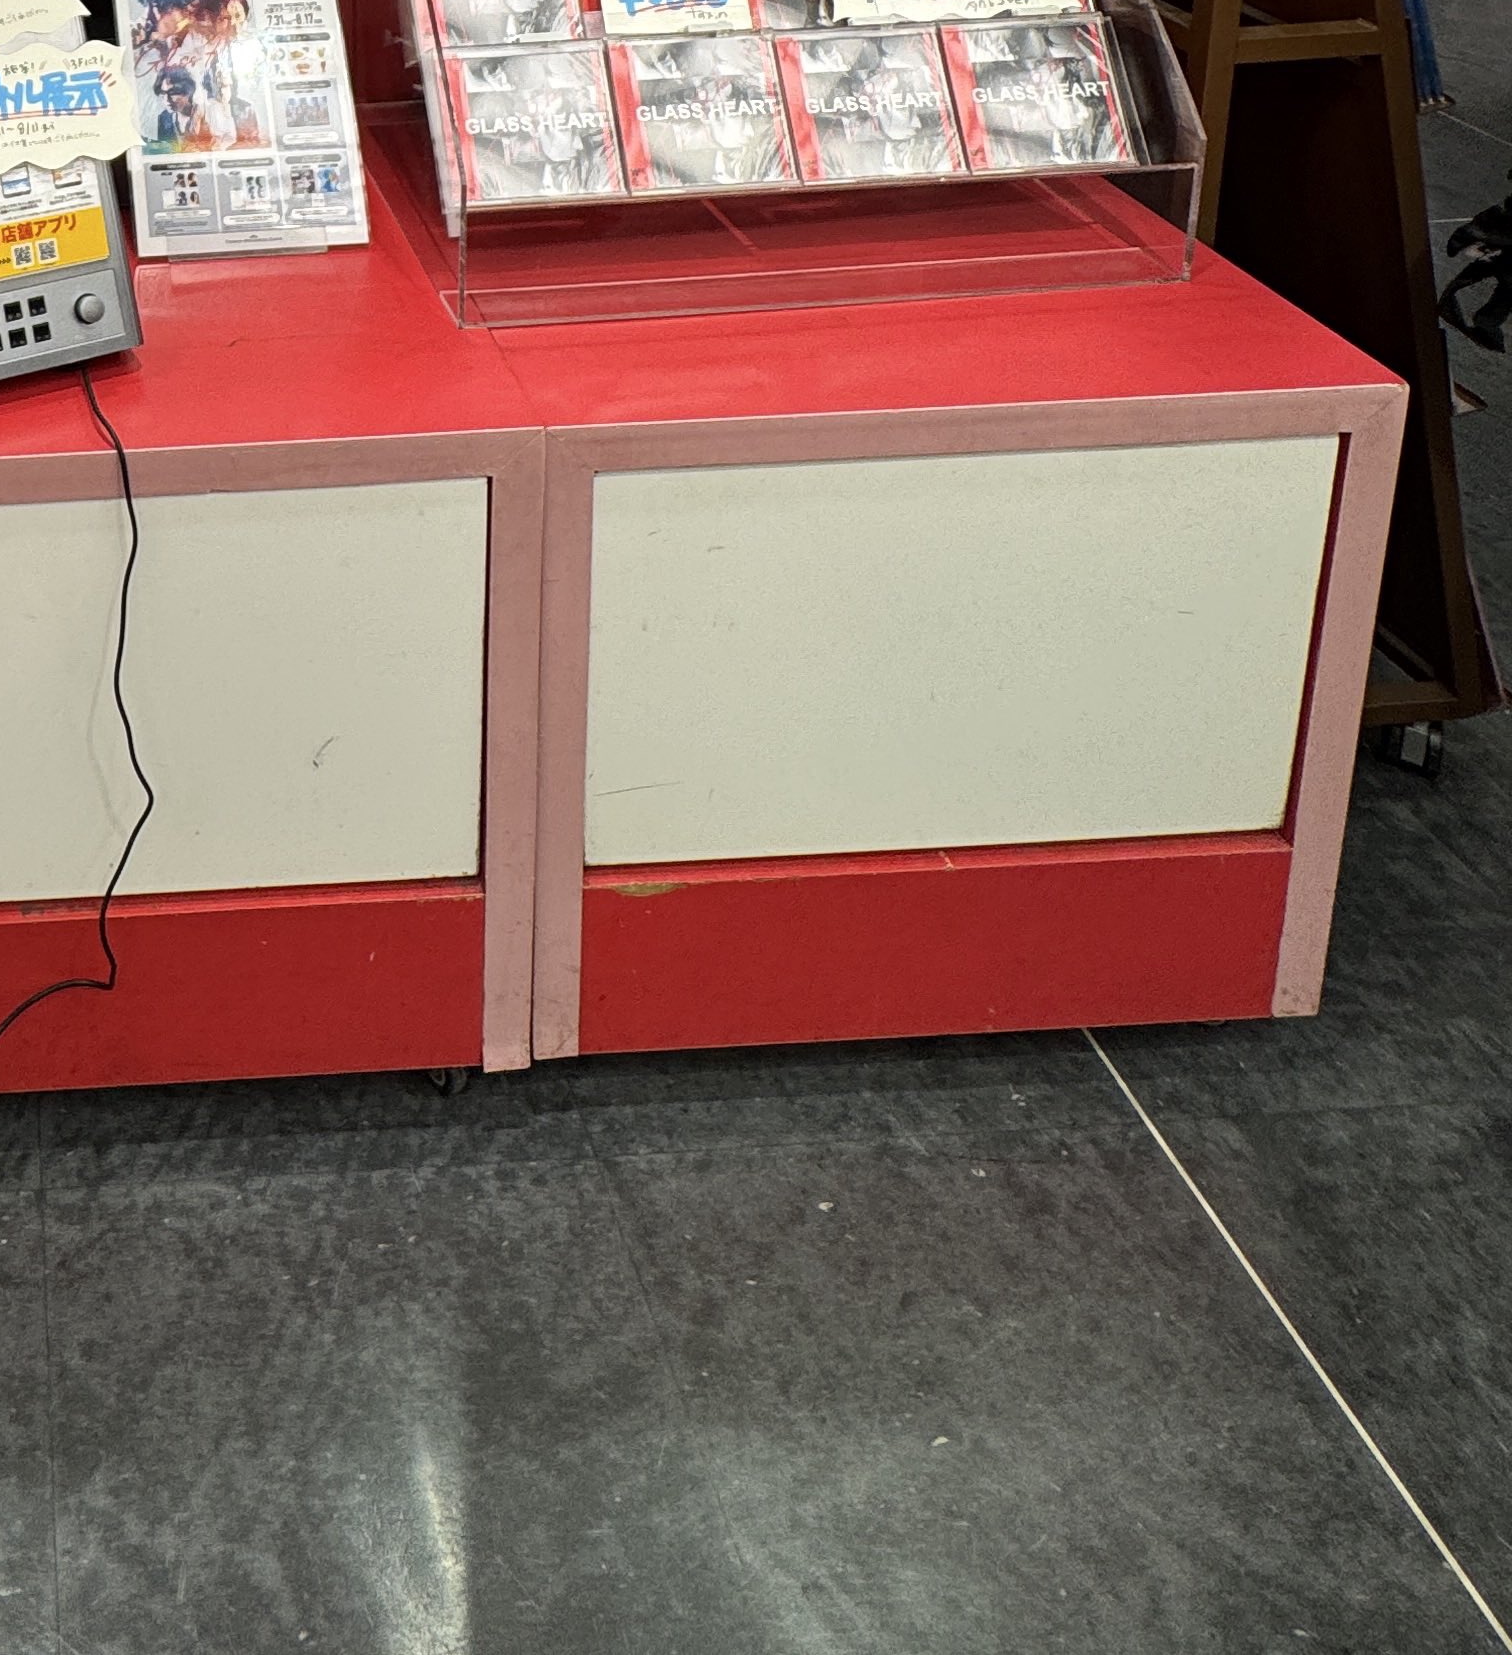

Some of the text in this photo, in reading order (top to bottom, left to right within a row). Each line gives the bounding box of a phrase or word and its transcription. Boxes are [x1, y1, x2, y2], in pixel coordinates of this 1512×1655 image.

[806, 90, 942, 115] GLASS HEART
[972, 80, 1110, 104] GLASS HEART
[636, 98, 777, 122] GLASS HEART
[465, 110, 606, 136] GLASS HEART
